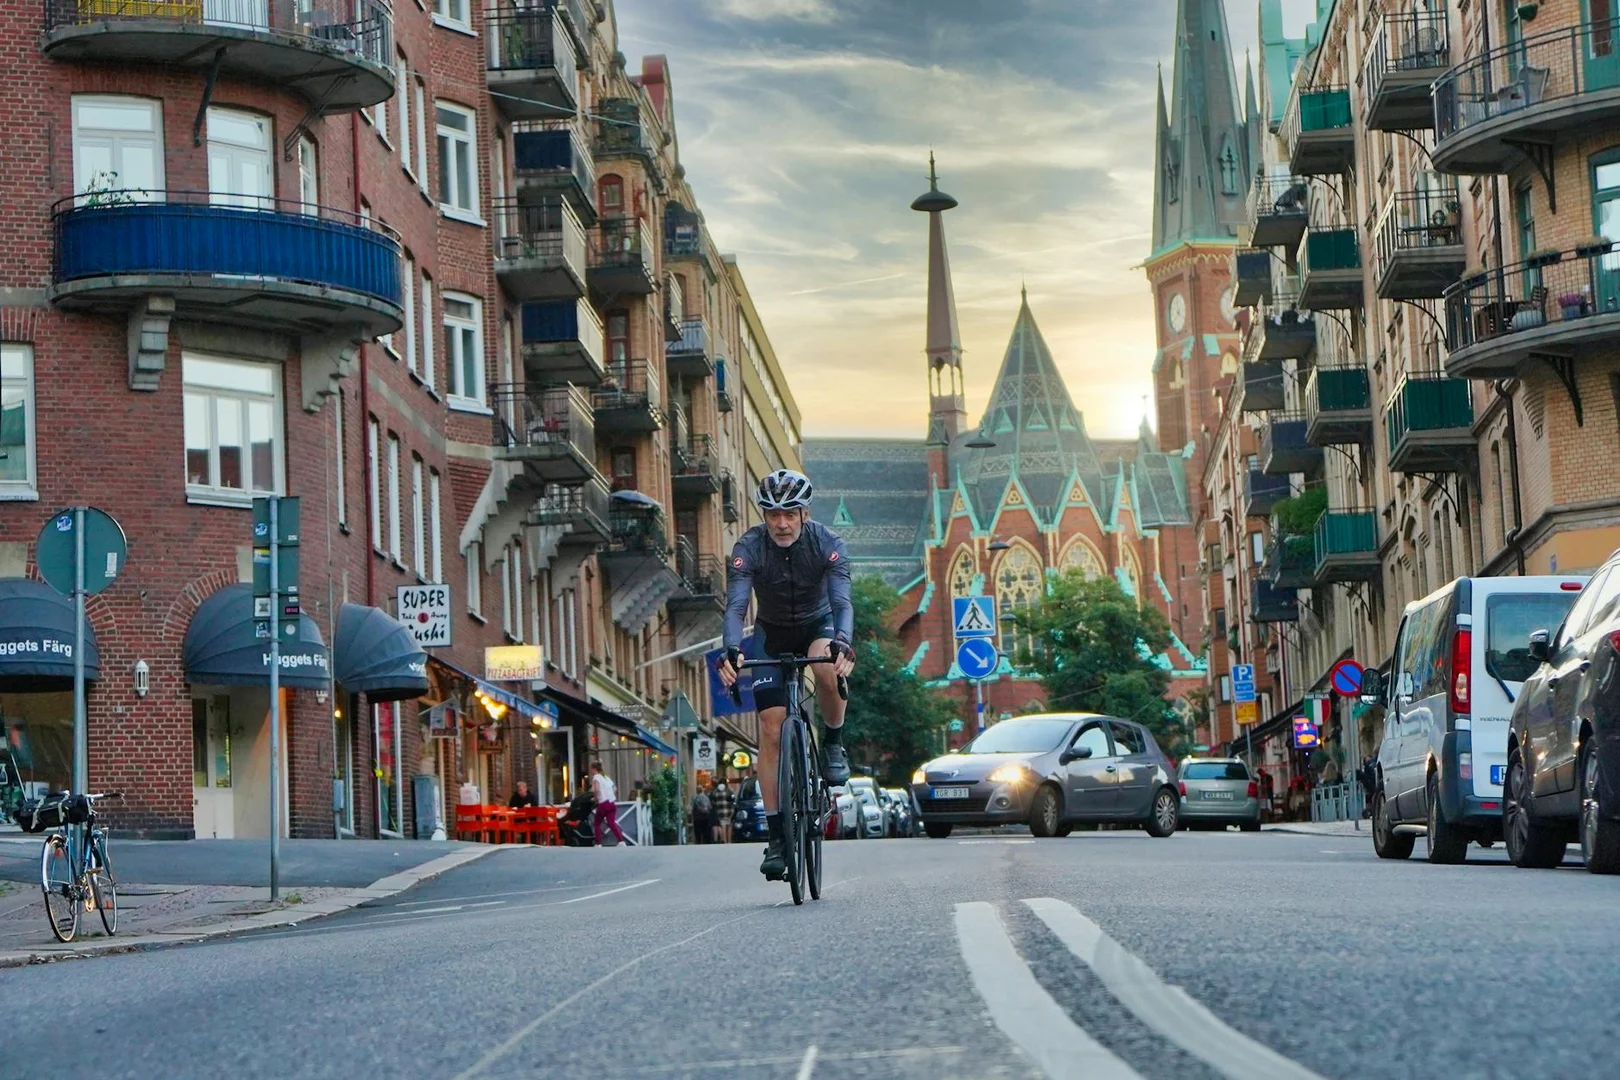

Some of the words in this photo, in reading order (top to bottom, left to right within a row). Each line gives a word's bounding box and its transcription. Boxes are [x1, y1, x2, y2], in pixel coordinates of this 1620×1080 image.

[403, 589, 445, 609] SUPER
[43, 639, 72, 657] Färg
[1238, 665, 1249, 680] P
